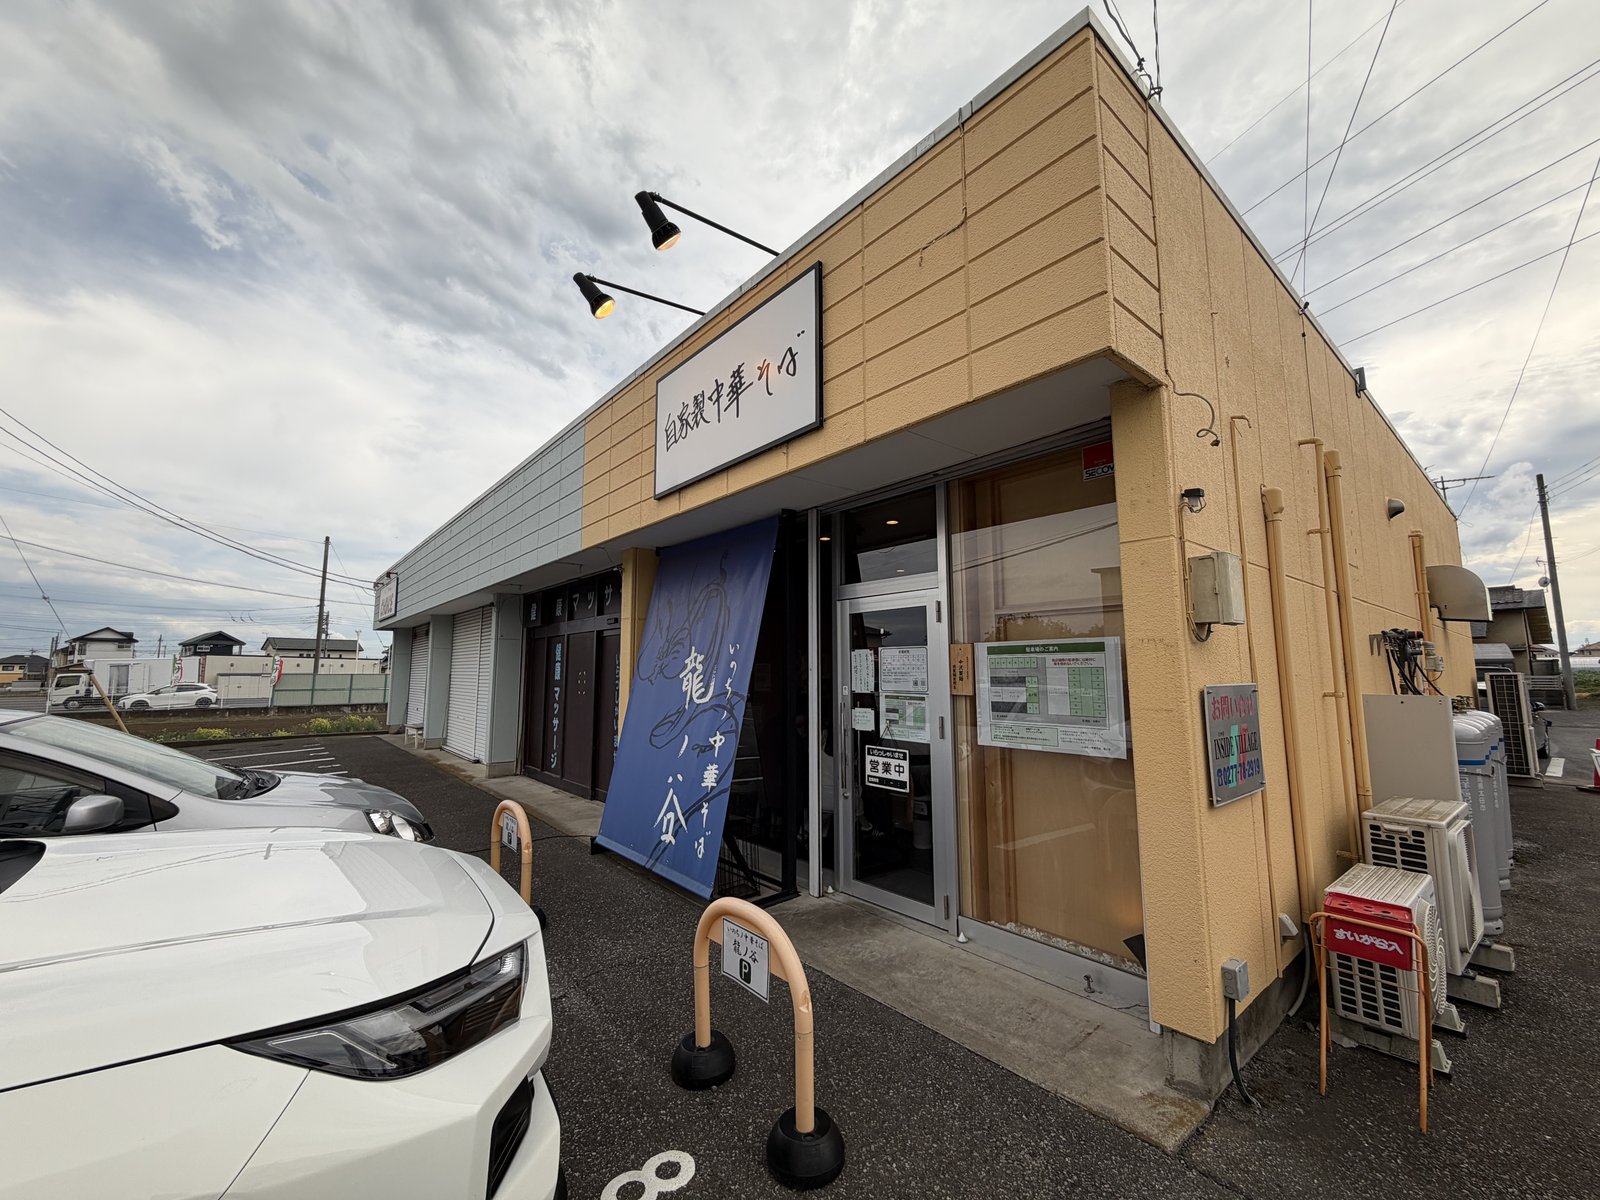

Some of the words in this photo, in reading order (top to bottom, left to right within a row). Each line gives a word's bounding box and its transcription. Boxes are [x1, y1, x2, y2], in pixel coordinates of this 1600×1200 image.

[664, 329, 805, 453] 自家製中華そば
[1213, 735, 1235, 760] INSIDE
[1234, 731, 1259, 756] VILLAGE
[869, 758, 905, 778] 営業中
[741, 960, 749, 980] P
